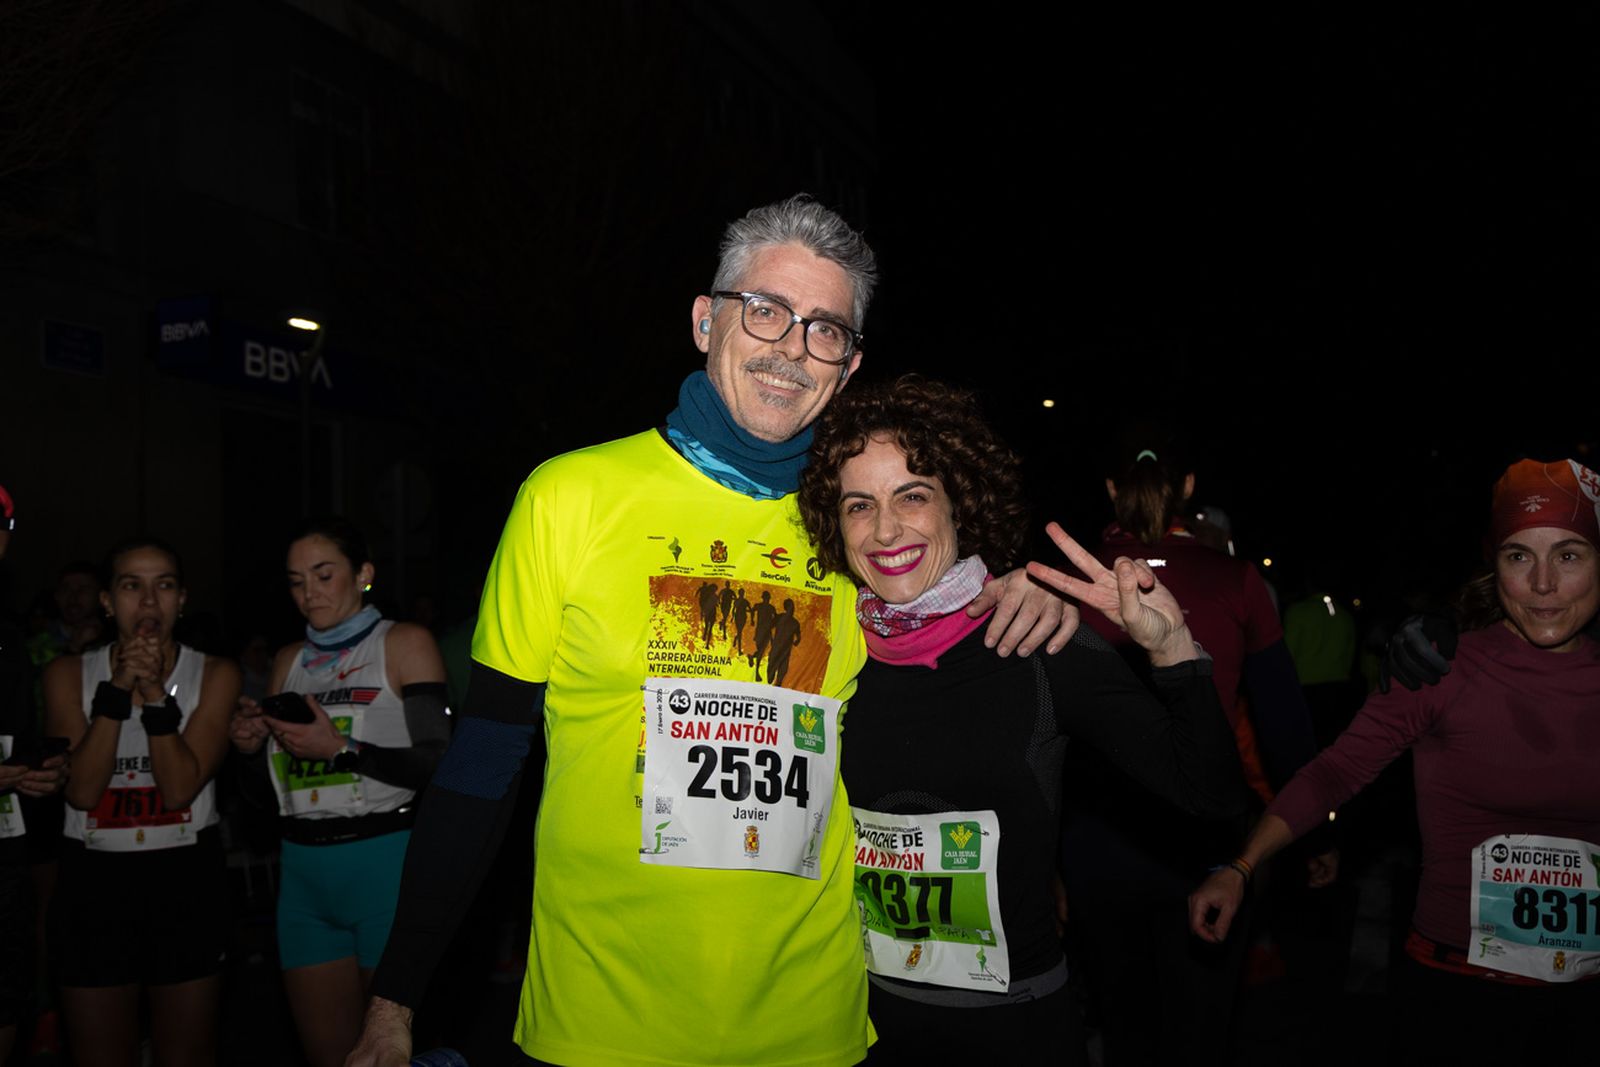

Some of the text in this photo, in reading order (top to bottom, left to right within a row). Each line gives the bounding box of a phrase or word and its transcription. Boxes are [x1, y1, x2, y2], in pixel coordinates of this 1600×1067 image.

[160, 319, 210, 343] BBVA
[243, 340, 333, 390] BBVA
[648, 639, 678, 650] XXXIV
[647, 651, 732, 666] CARRERA URBANA
[670, 694, 689, 708] 43
[694, 700, 778, 722] NOCHE DE
[670, 720, 711, 740] SAN
[715, 720, 779, 746] ANTÓN
[687, 744, 810, 809] 2534
[732, 806, 769, 821] Javier
[902, 832, 924, 848] DE
[854, 846, 924, 871] AN ANTÓN
[1511, 851, 1581, 868] NOCHE DE
[1493, 868, 1582, 888] SAN ANTÓN
[1513, 887, 1600, 936] 8311
[1538, 935, 1582, 949] Aranzazu
